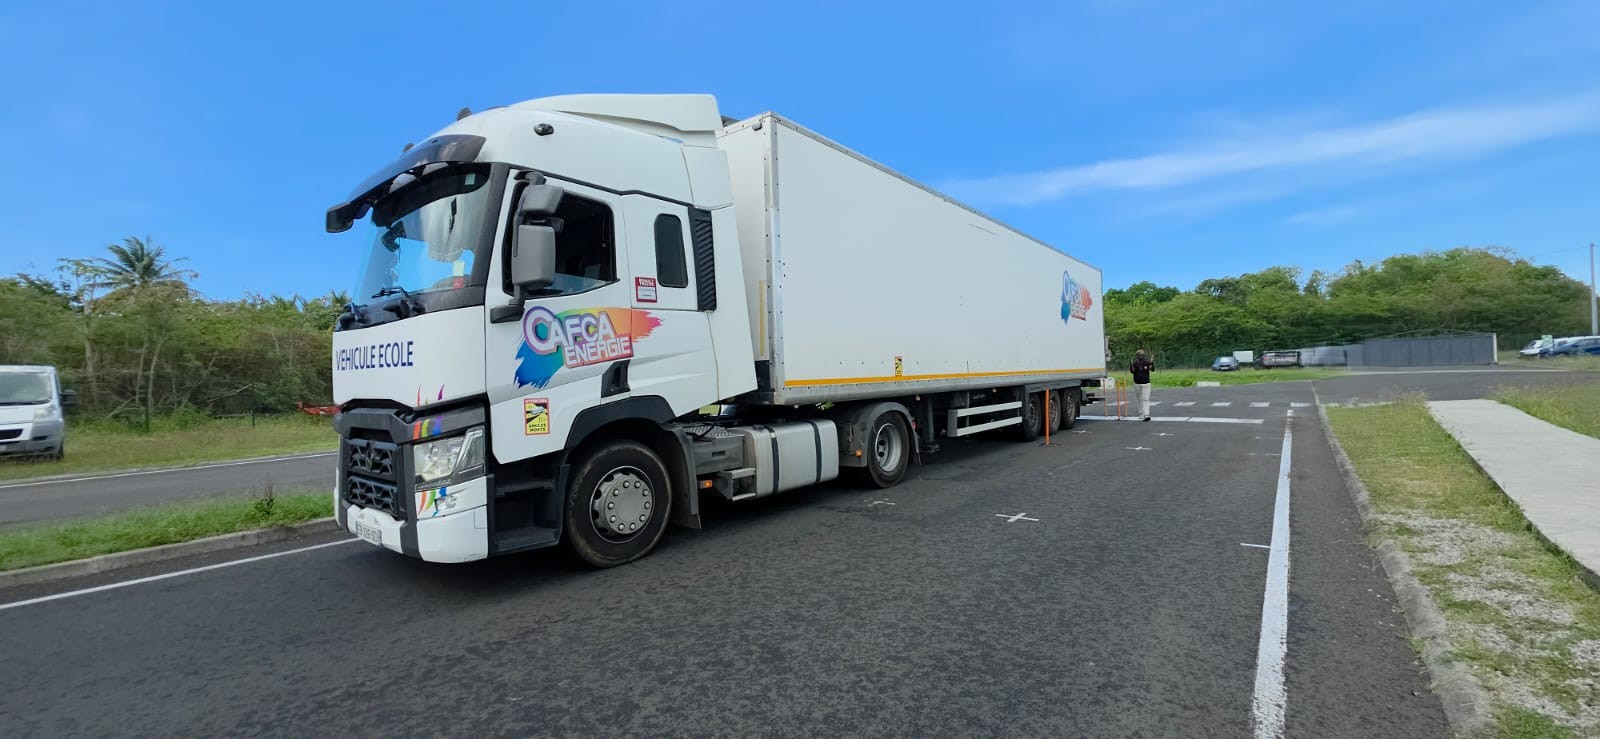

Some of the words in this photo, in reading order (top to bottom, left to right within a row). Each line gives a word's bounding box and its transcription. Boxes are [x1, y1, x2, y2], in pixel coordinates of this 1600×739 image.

[523, 306, 616, 354] CAFCA
[336, 345, 375, 371] VEHICULE
[379, 341, 413, 368] ECOLE
[564, 336, 631, 365] ENERGIE
